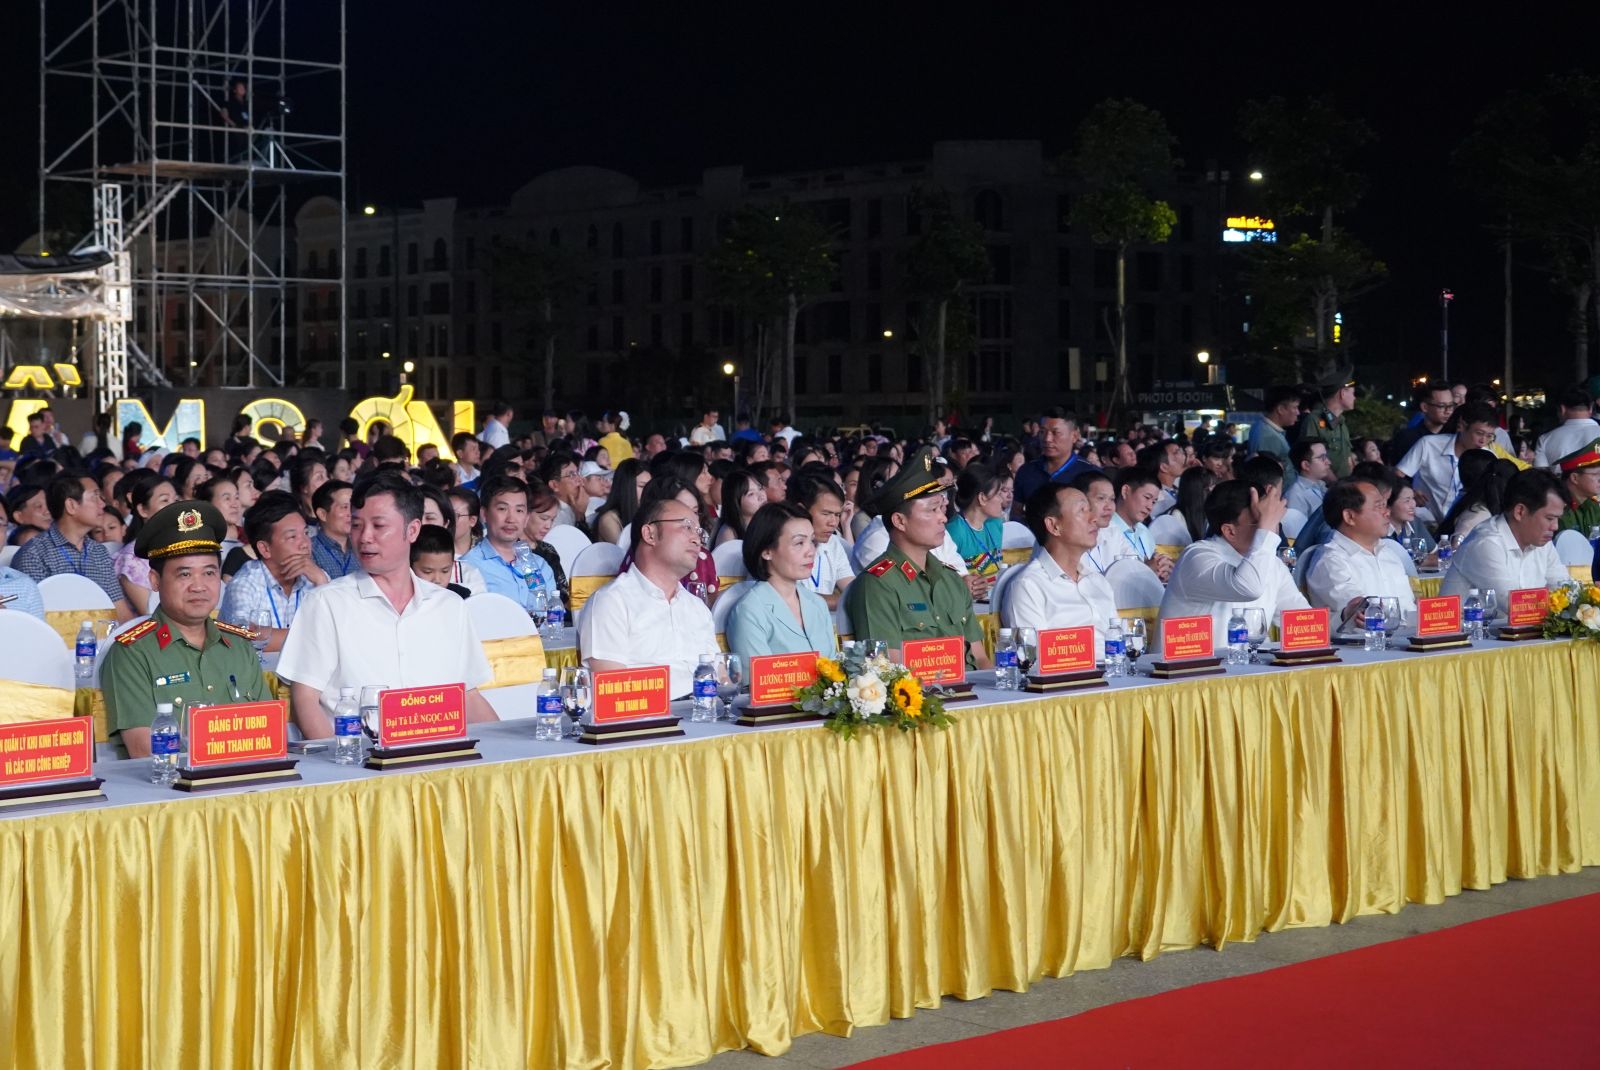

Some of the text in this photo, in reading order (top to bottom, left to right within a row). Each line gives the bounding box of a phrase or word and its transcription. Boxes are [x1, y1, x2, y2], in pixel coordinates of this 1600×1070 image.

[1138, 391, 1213, 403] PHOTO BOOTH
[922, 643, 944, 652] ĐỒNG CHÍ
[788, 659, 798, 667] CHÍ
[910, 658, 922, 668] CAO
[936, 653, 957, 666] CƯỜNG
[760, 672, 810, 686] LƯƠNG THỊ HOA
[401, 692, 444, 706] ĐỒNG CHÍ
[208, 714, 268, 733] ĐẢNG ỦY UBND
[386, 718, 398, 728] Đại
[408, 712, 420, 725] LÊ
[420, 712, 442, 724] NGỌC
[443, 710, 460, 721] ANH
[4, 733, 19, 754] QUẢN
[20, 734, 26, 750] LÝ
[26, 735, 38, 750] KHU
[38, 734, 52, 748] KINH
[52, 729, 59, 747] TẾ
[60, 732, 72, 746] NGHI
[72, 730, 84, 745] SƠN
[206, 735, 272, 756] TỈNH THANH HÓA
[5, 752, 72, 776] VÀ CÁC KHU CÔNG NGHIỆP
